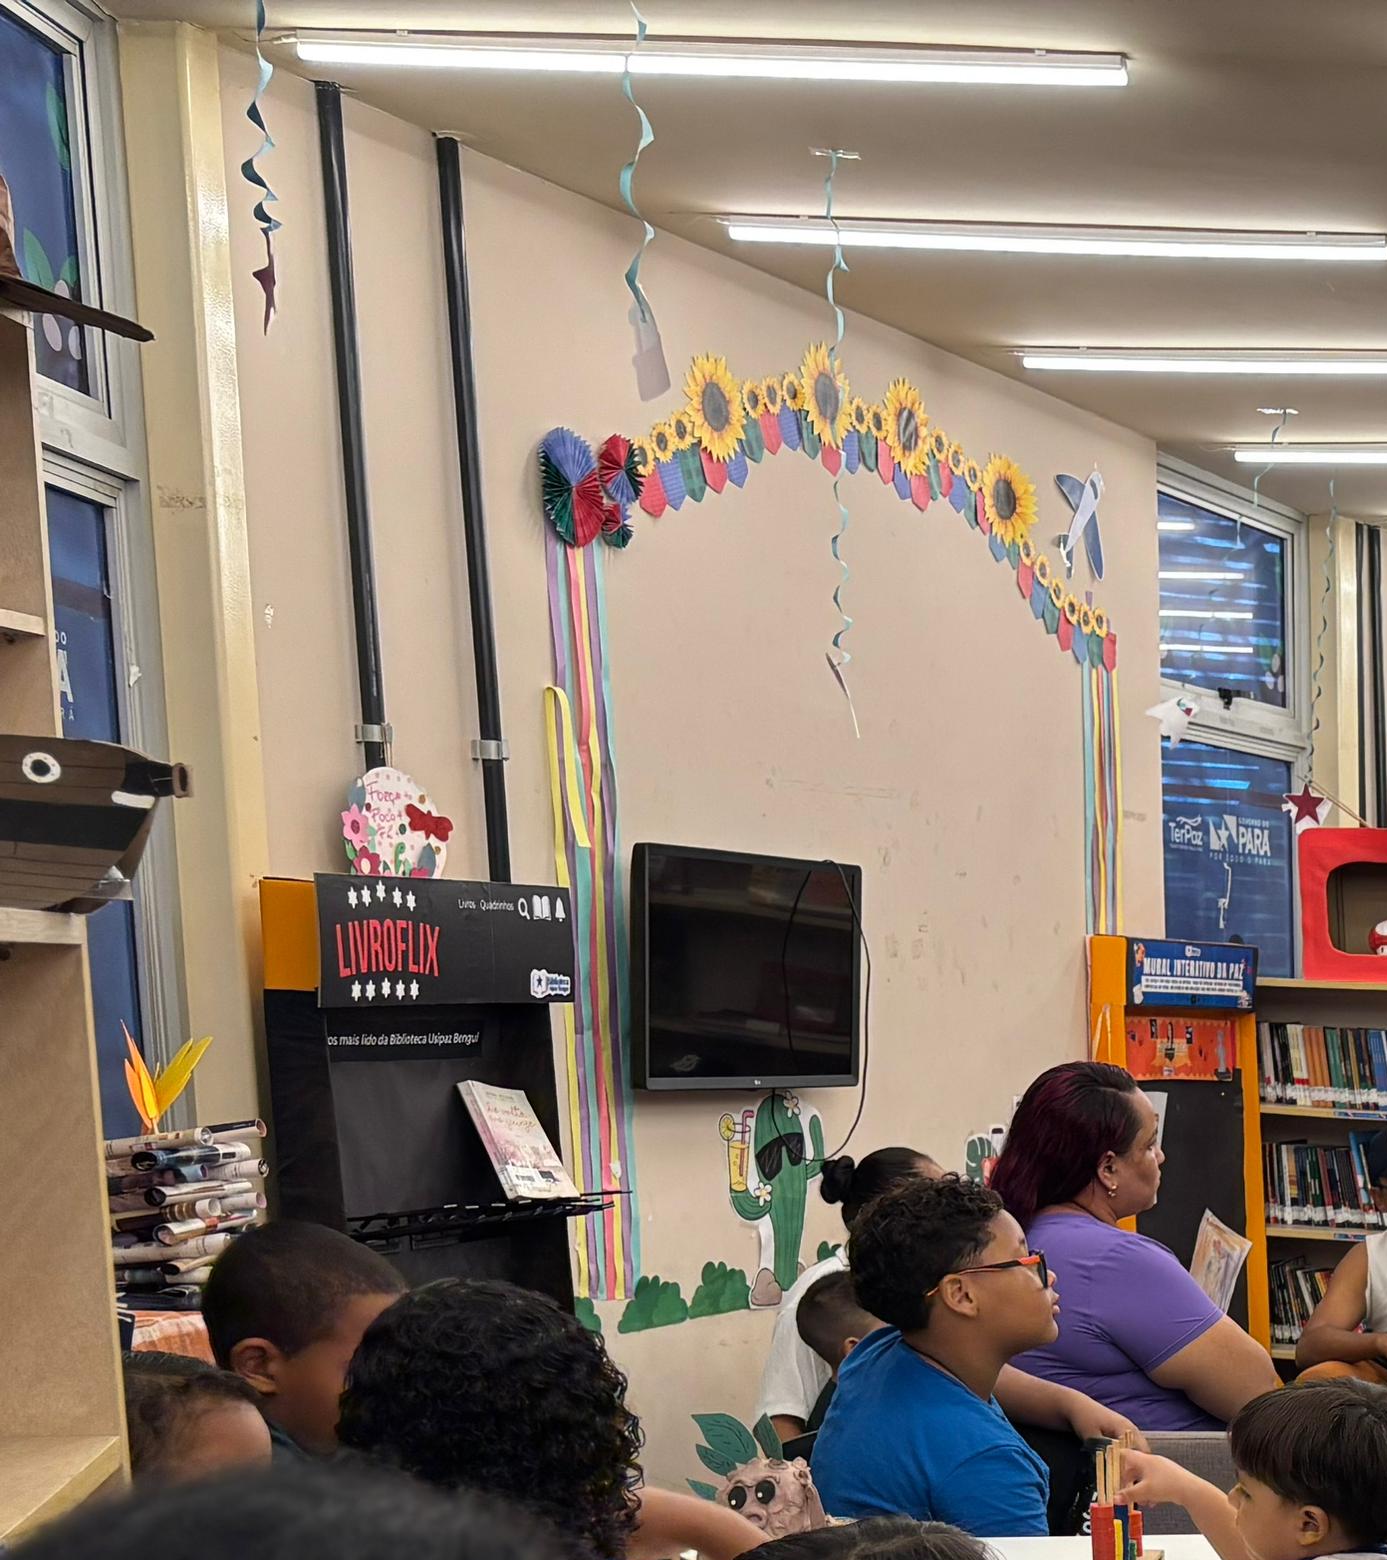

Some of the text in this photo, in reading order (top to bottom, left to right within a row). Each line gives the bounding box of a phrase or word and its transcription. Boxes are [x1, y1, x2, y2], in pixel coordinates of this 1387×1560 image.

[1168, 822, 1204, 845] TerPaz
[335, 919, 440, 978] LIVROFLIX
[1143, 957, 1244, 979] MURAL INTERATIVO DA PAZ
[339, 1034, 359, 1046] mais
[361, 1034, 377, 1046] lido
[378, 1034, 388, 1046] da
[390, 1033, 427, 1046] Biblioteca
